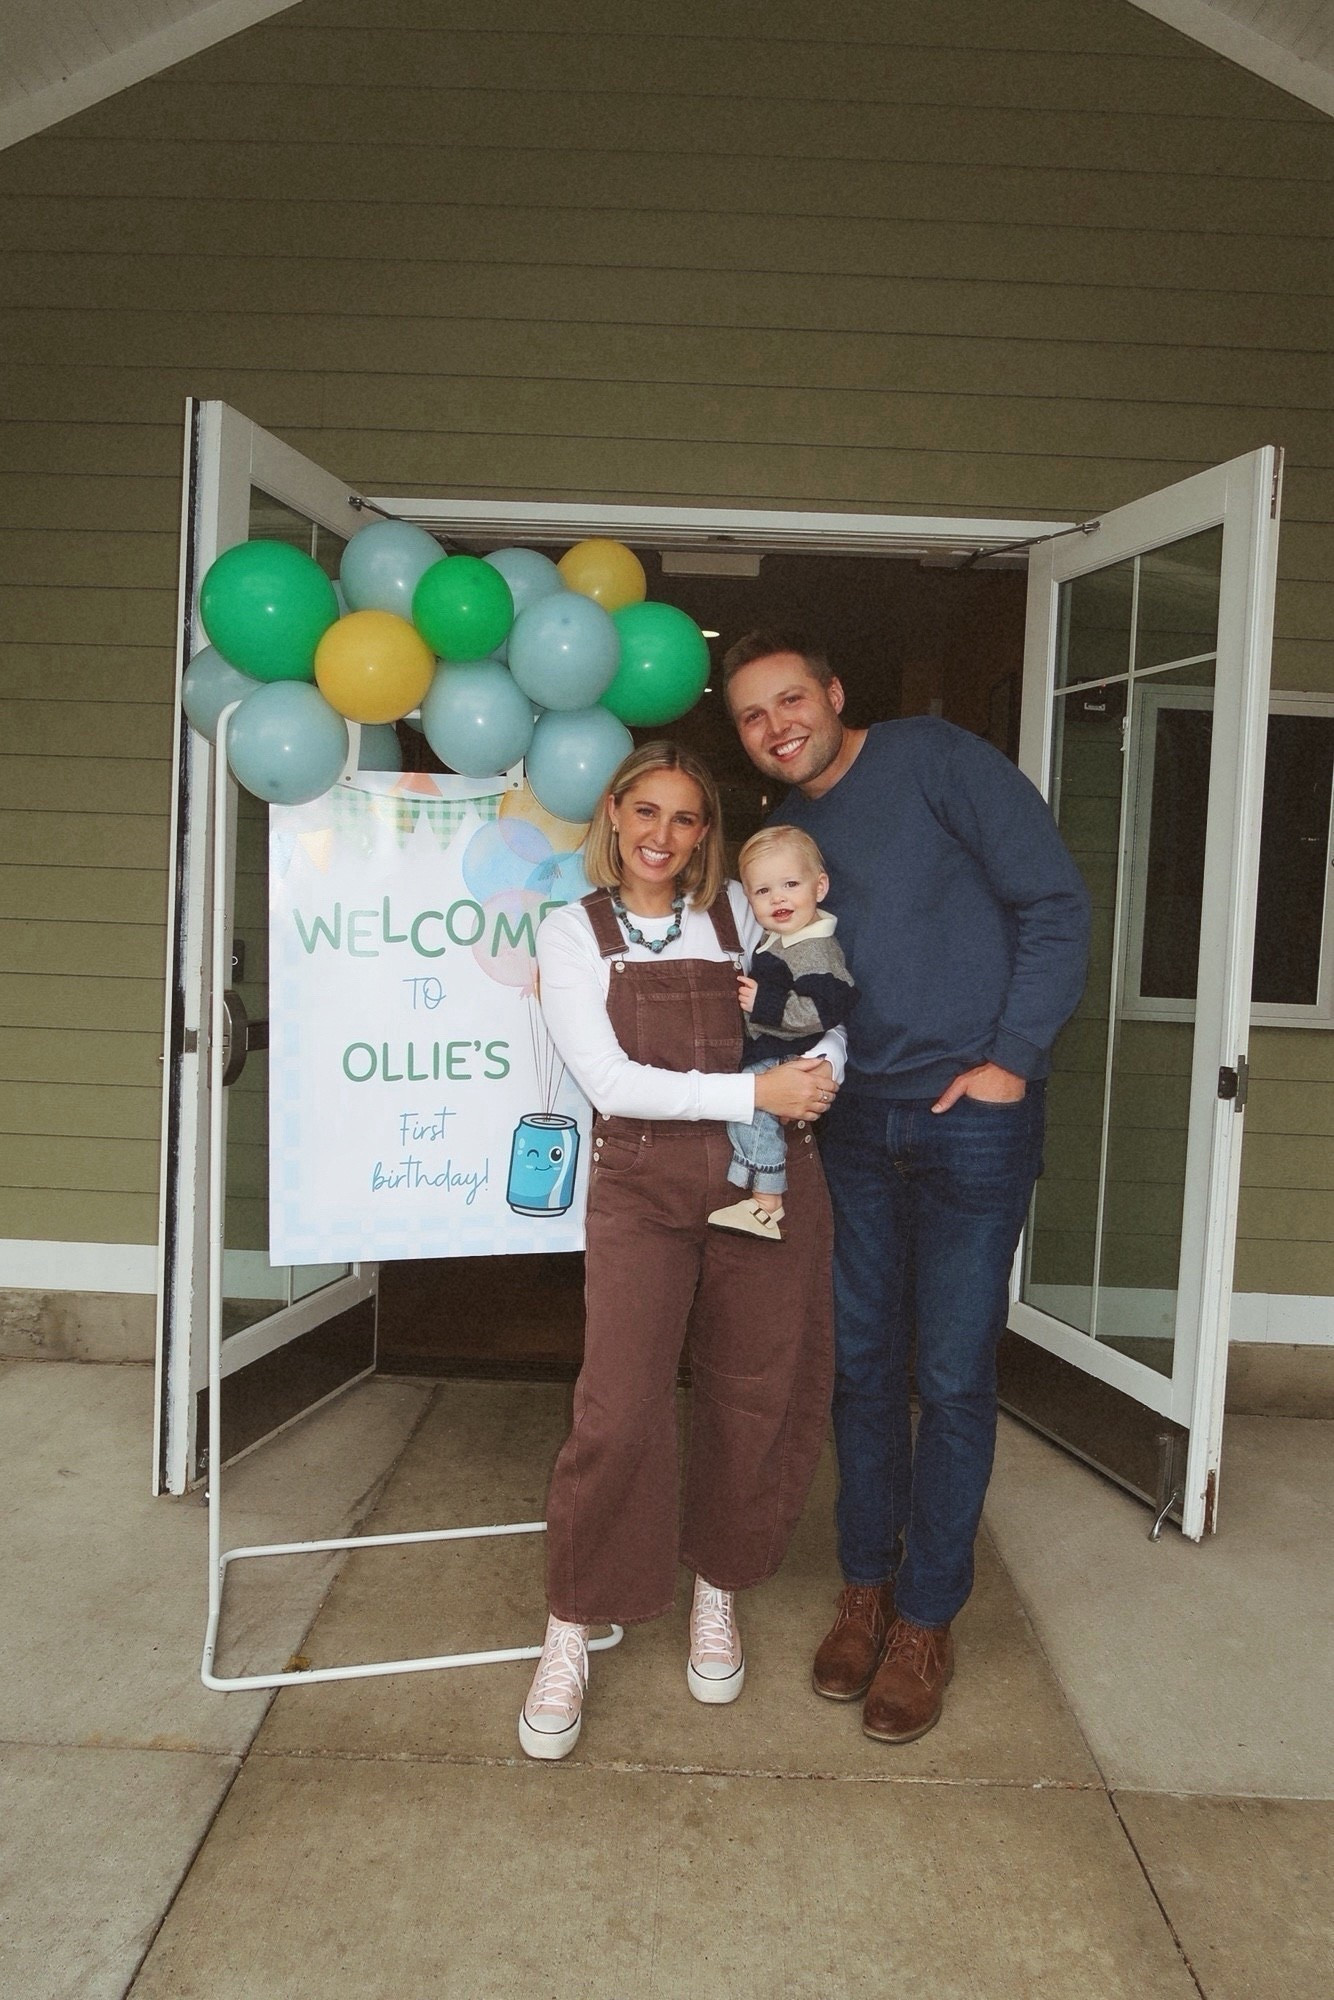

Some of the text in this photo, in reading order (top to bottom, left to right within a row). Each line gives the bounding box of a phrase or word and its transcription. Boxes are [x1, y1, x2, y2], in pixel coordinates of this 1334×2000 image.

[402, 976, 447, 1010] TO
[399, 1106, 457, 1146] First
[371, 1156, 490, 1206] birthday!
